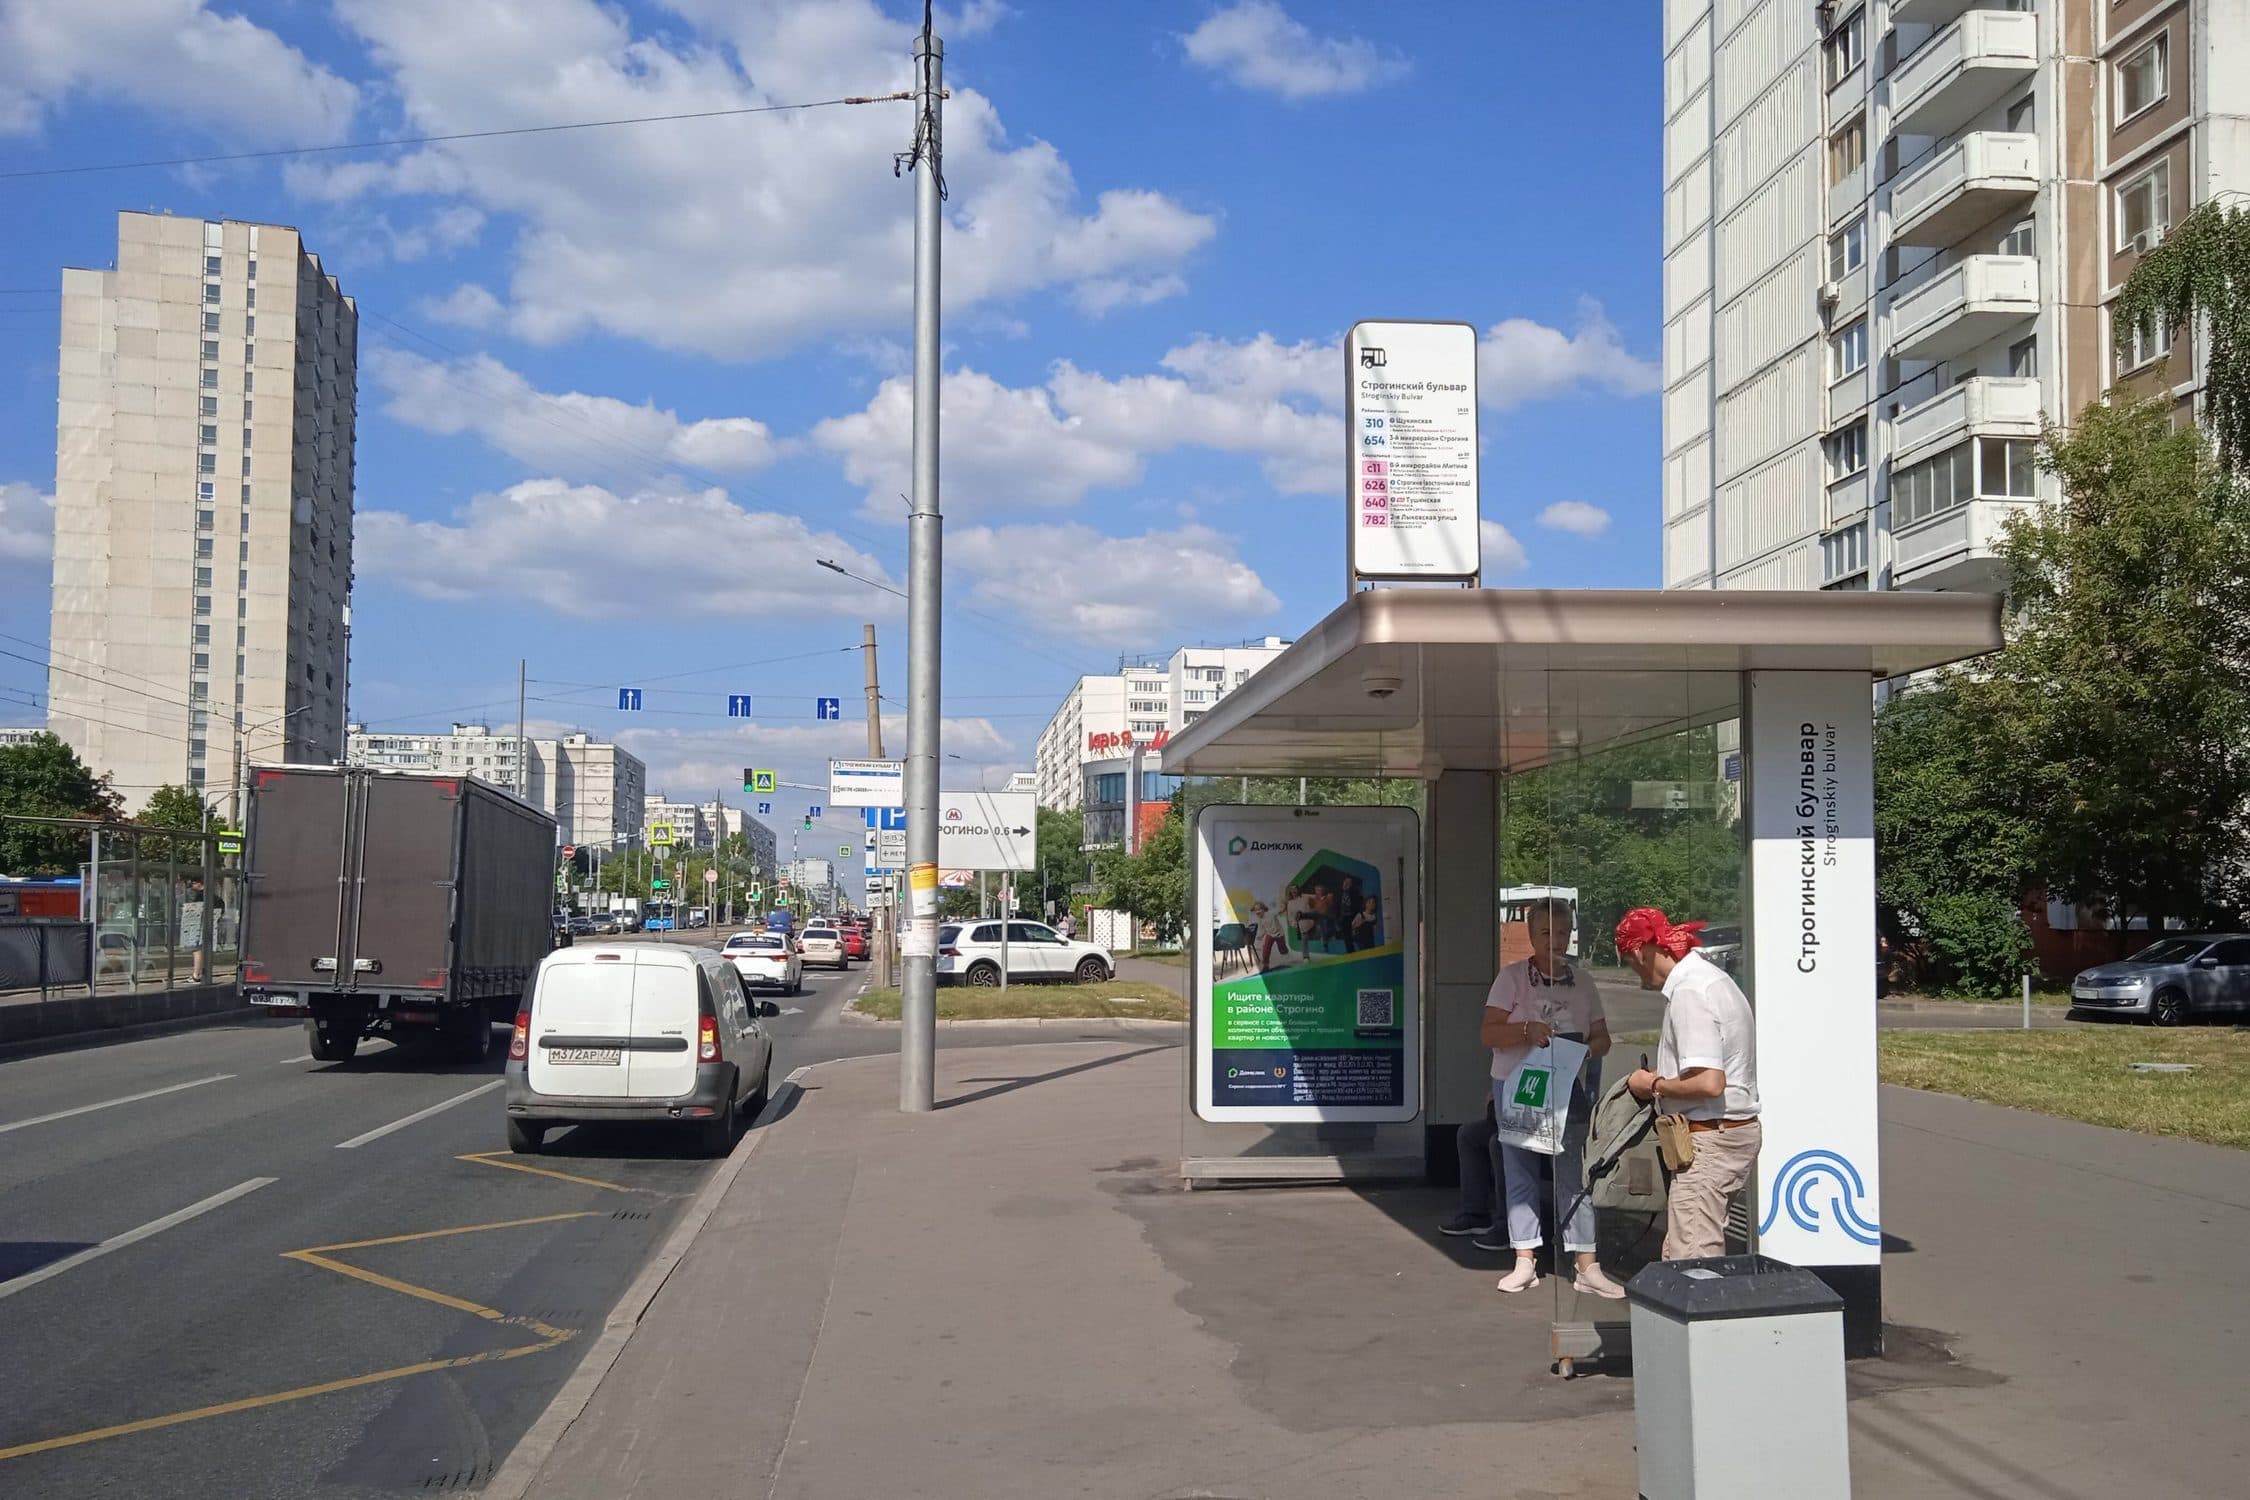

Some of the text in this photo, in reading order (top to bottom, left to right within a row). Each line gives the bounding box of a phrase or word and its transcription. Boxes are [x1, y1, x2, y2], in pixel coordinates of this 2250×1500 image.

[1361, 380, 1467, 393] Строгинский бульвар
[1361, 391, 1400, 401] Stroginskiy
[1365, 418, 1384, 429] 310
[1396, 417, 1432, 425] Щукинская
[1364, 436, 1386, 446] 654
[1400, 435, 1439, 443] микрорайон
[1400, 463, 1441, 471] микрорайон
[1365, 481, 1386, 490] 626
[1365, 498, 1386, 508] 640
[1406, 497, 1441, 505] Тушинская
[1365, 515, 1386, 525] 782
[1822, 723, 1840, 867] Stroginskiy bulvar
[994, 826, 1010, 836] 0.6
[1251, 840, 1303, 852] Домклик
[1795, 722, 1820, 973] Строгинский бульвар
[1227, 991, 1314, 1003] Ищите квартиры
[1236, 1004, 1273, 1015] районе
[1276, 1004, 1325, 1015] Строгино
